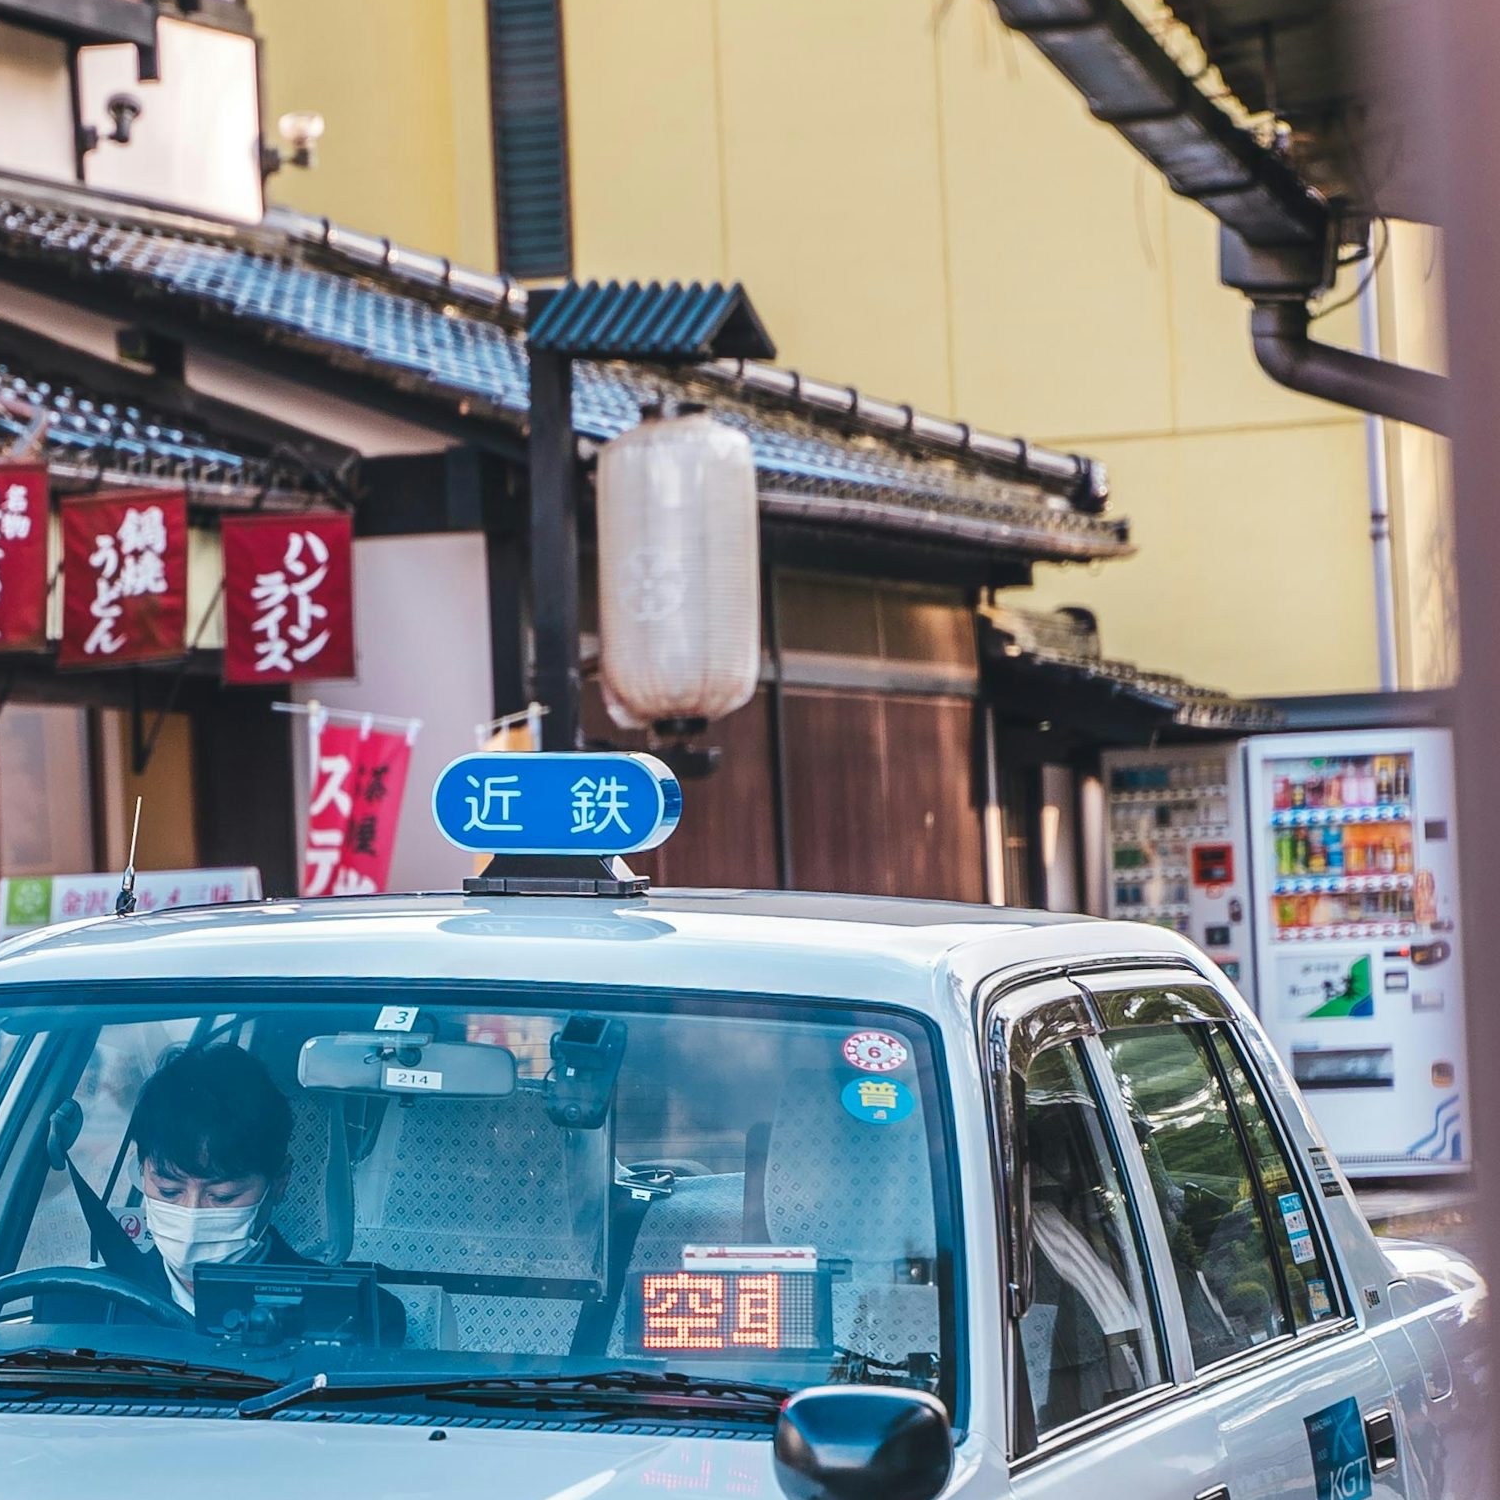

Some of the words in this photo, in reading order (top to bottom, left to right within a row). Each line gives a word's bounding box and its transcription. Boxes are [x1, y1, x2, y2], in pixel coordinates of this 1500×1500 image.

[1, 483, 32, 540] 名物
[250, 570, 294, 673] ライス
[283, 530, 331, 663] ハントン
[462, 774, 633, 836] 近鉄
[393, 1011, 409, 1025] 3
[397, 1072, 429, 1085] 214
[867, 1046, 882, 1059] 6
